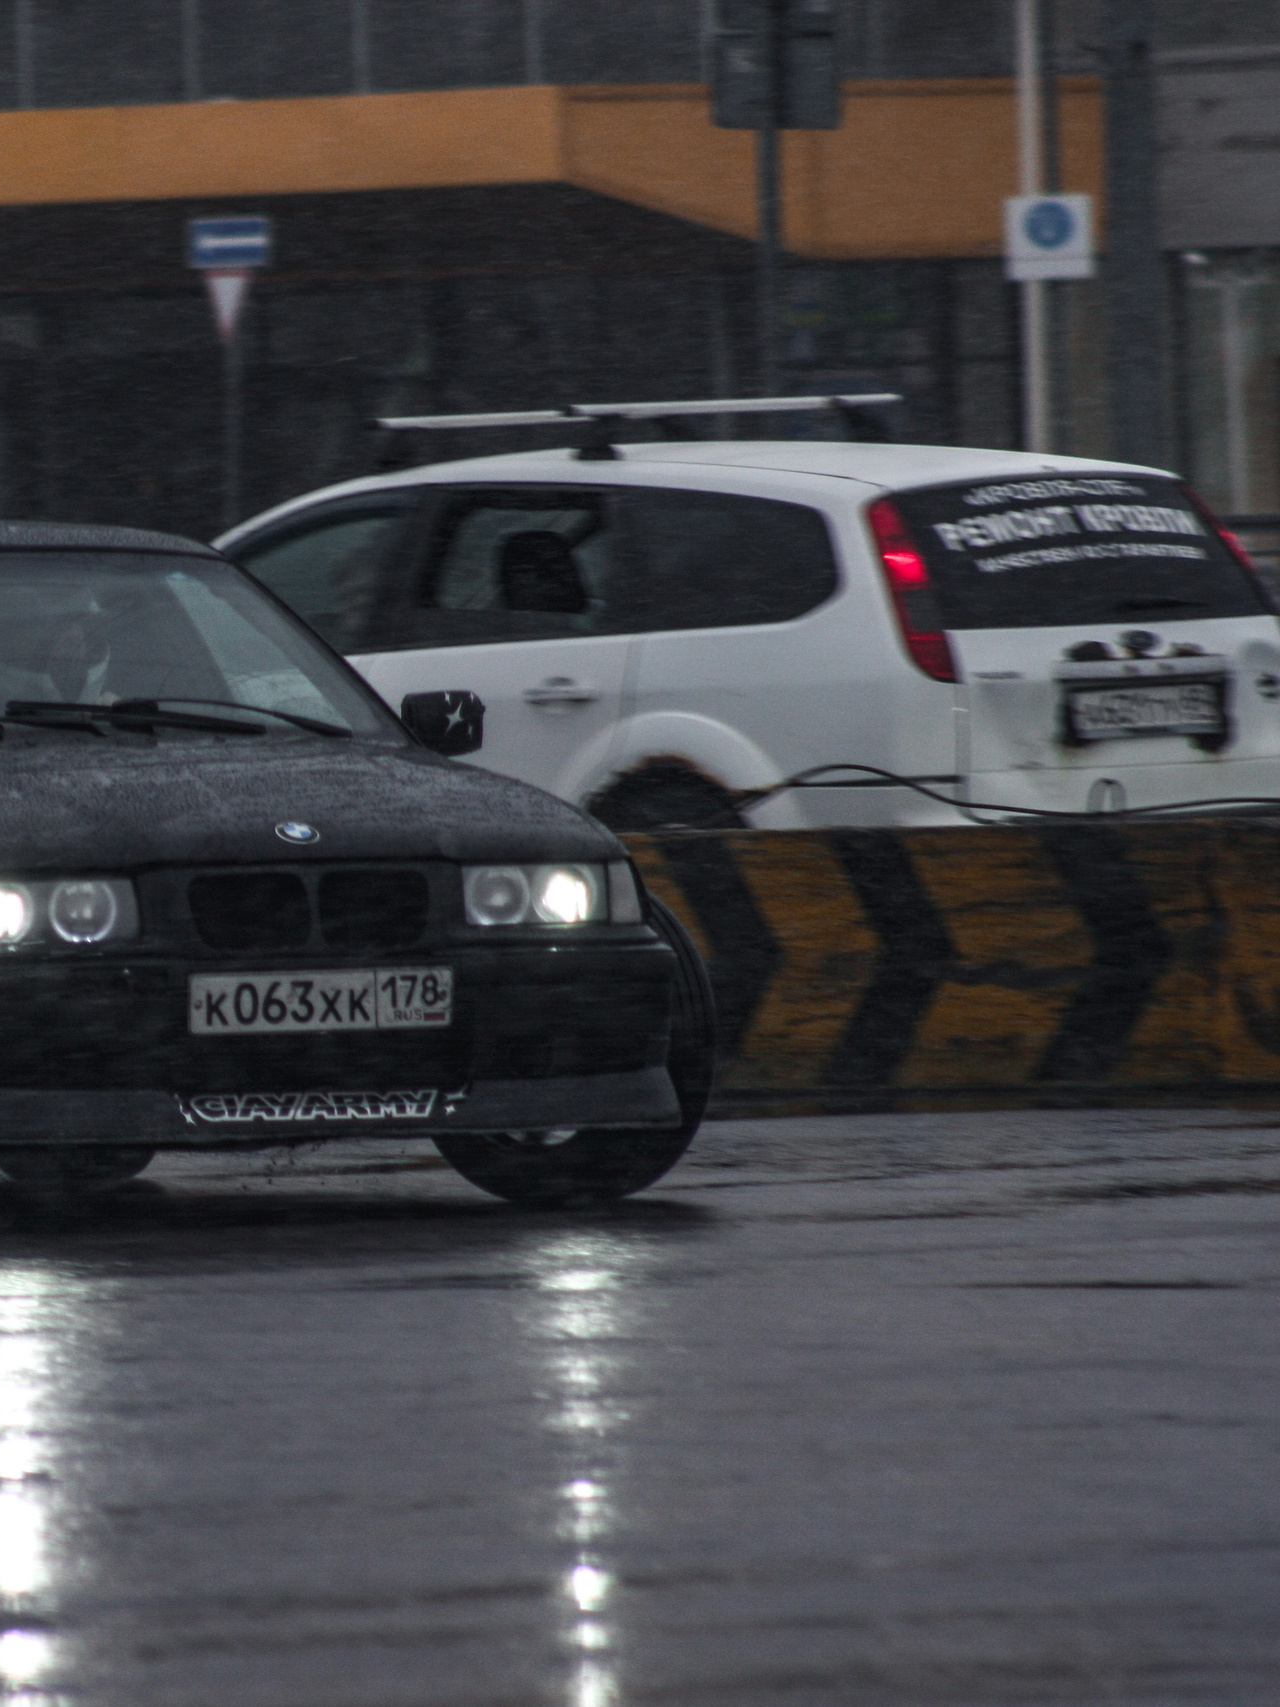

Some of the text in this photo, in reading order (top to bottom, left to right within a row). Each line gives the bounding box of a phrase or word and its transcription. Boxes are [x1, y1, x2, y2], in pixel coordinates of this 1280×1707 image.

[932, 505, 1081, 551] РЕМОНТ
[205, 974, 440, 1026] К063ХК 178
[393, 1009, 424, 1022] RUS
